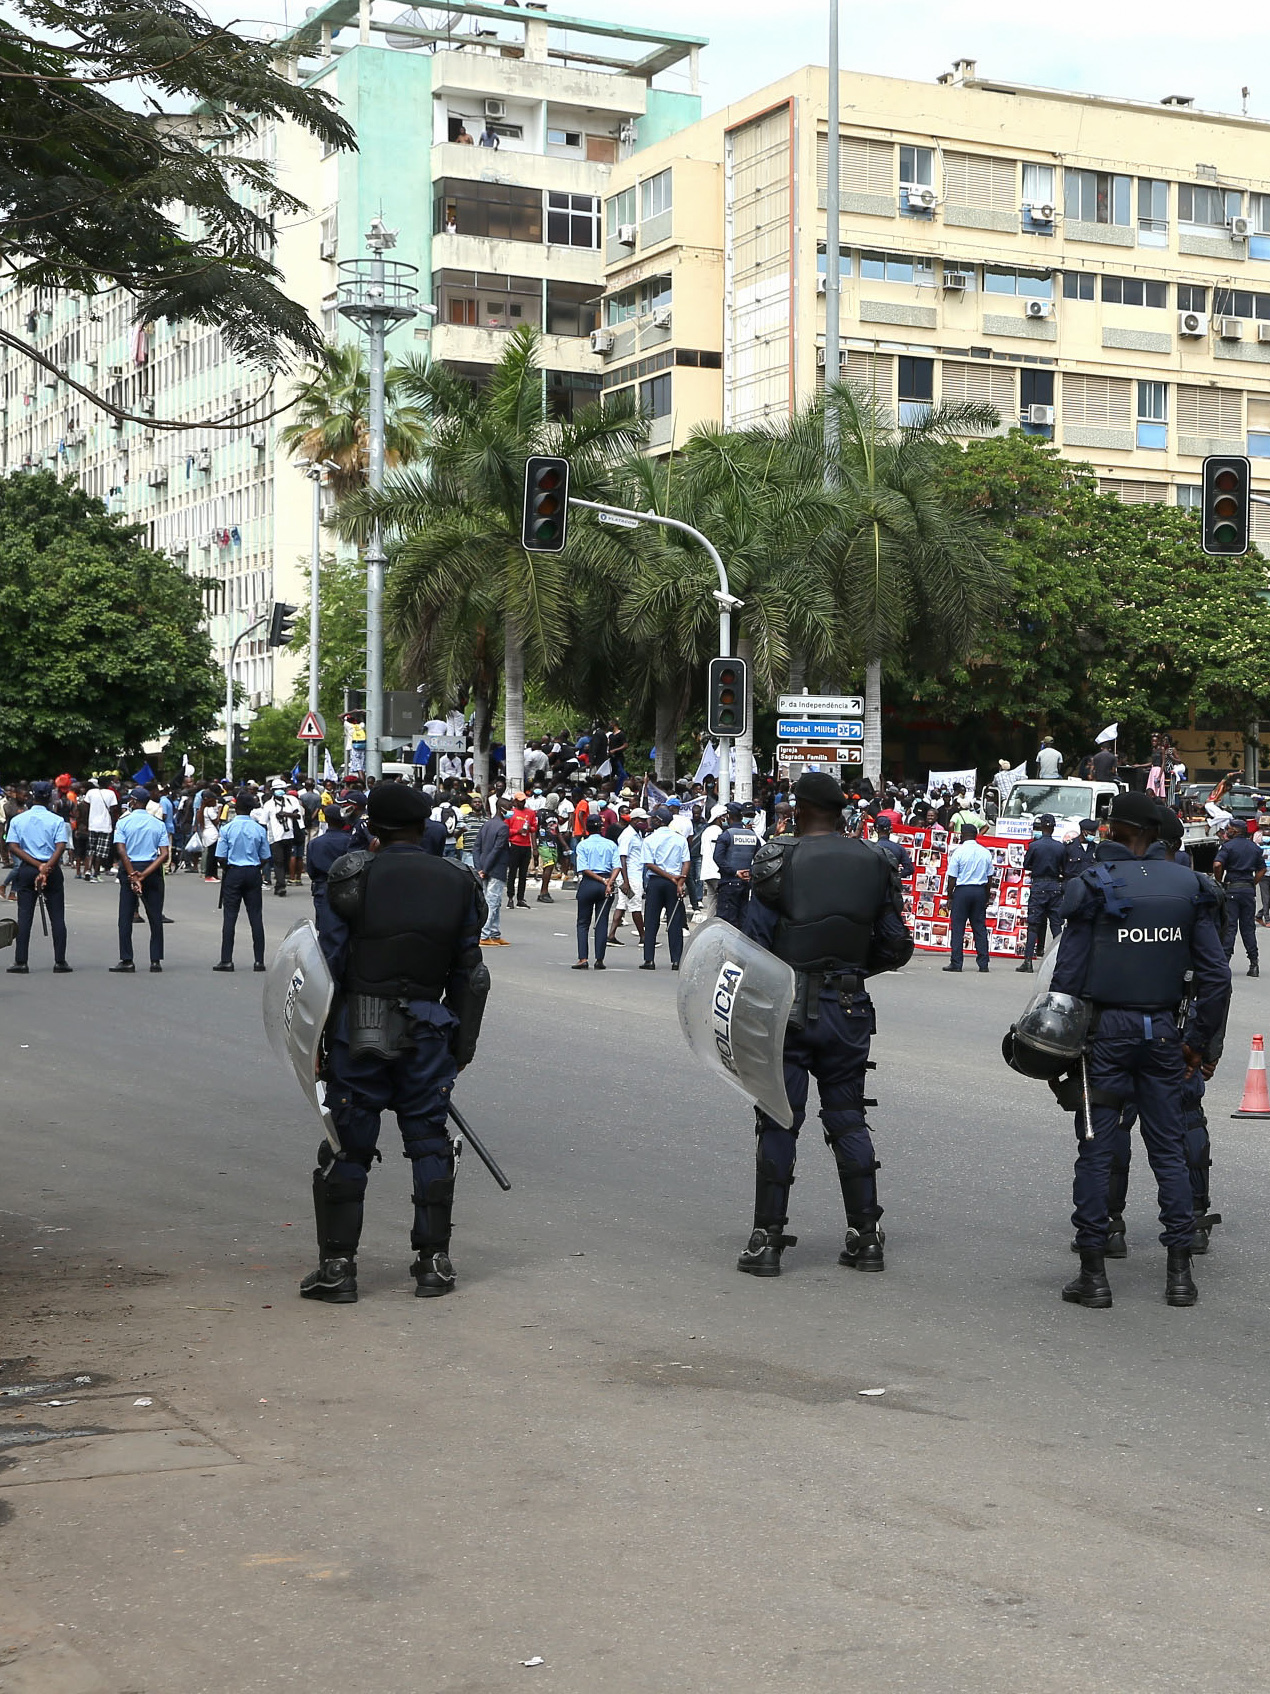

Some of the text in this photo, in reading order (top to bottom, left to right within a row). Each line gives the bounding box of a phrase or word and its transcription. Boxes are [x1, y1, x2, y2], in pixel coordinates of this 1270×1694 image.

[799, 701, 849, 709] Independência
[780, 725, 838, 734] Hospital Militar
[780, 746, 798, 754] Igreja
[780, 753, 805, 761] Sagrada
[1117, 927, 1182, 943] POLICIA
[714, 969, 742, 1077] POLICIA
